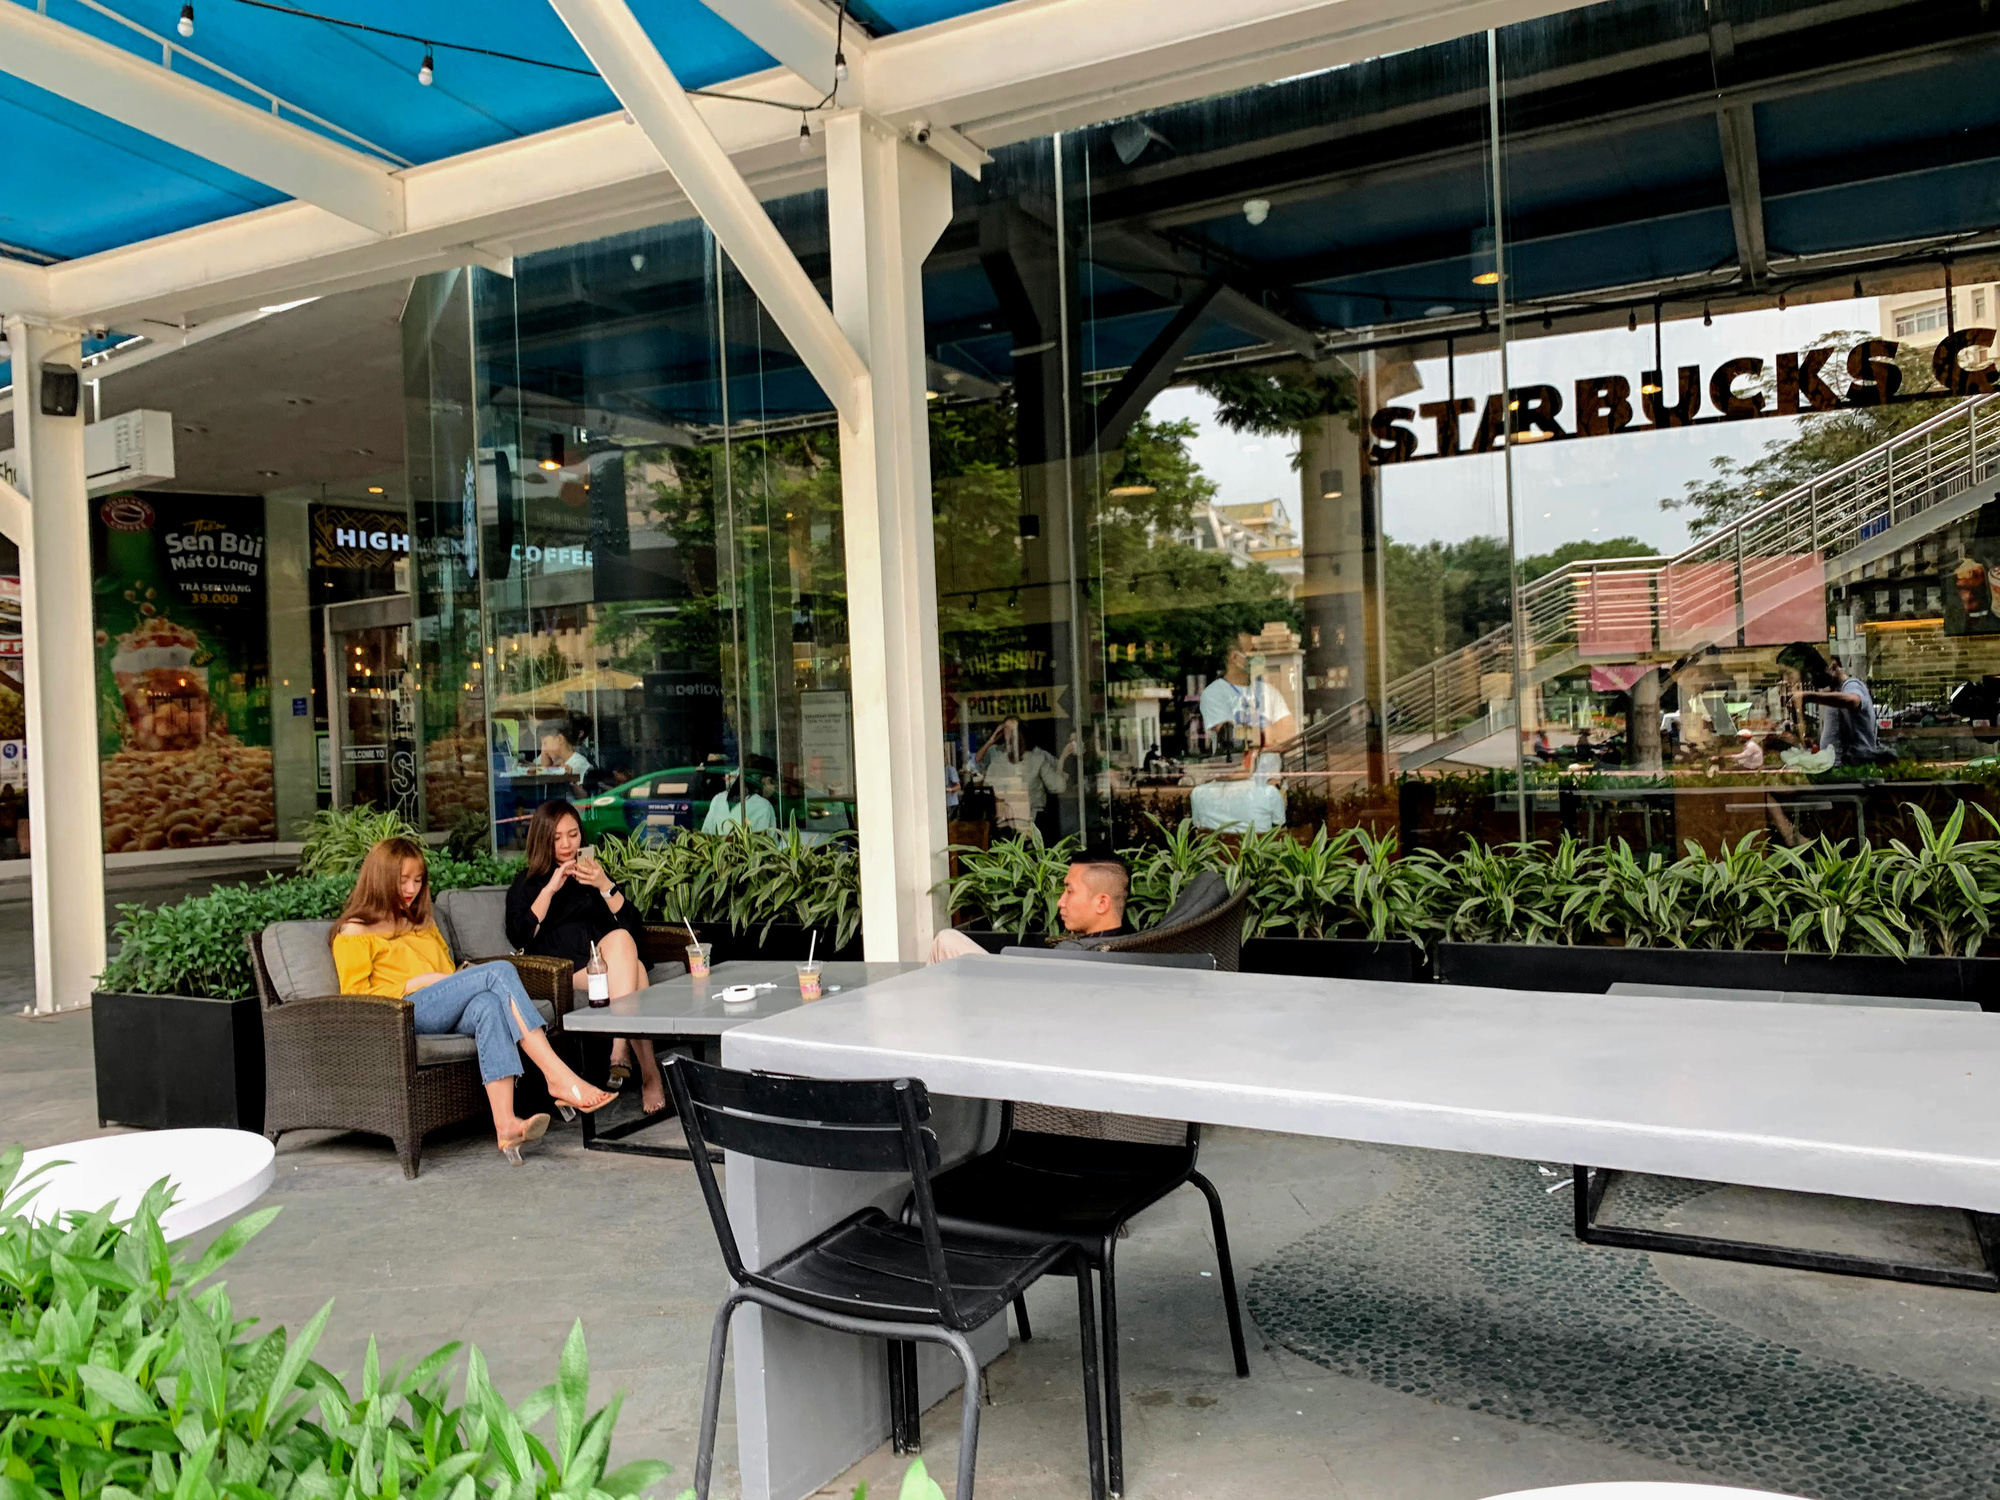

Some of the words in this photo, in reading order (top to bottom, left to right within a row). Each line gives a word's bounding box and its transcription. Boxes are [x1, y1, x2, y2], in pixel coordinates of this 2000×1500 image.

[1369, 341, 1902, 465] STARBUCKS
[165, 532, 215, 554] Sen
[220, 532, 264, 558] Bùi
[511, 544, 594, 569] COFFEE
[170, 553, 204, 571] Mát
[206, 552, 219, 569] Ô
[220, 556, 259, 577] Long
[968, 692, 1052, 716] POTENTIAL
